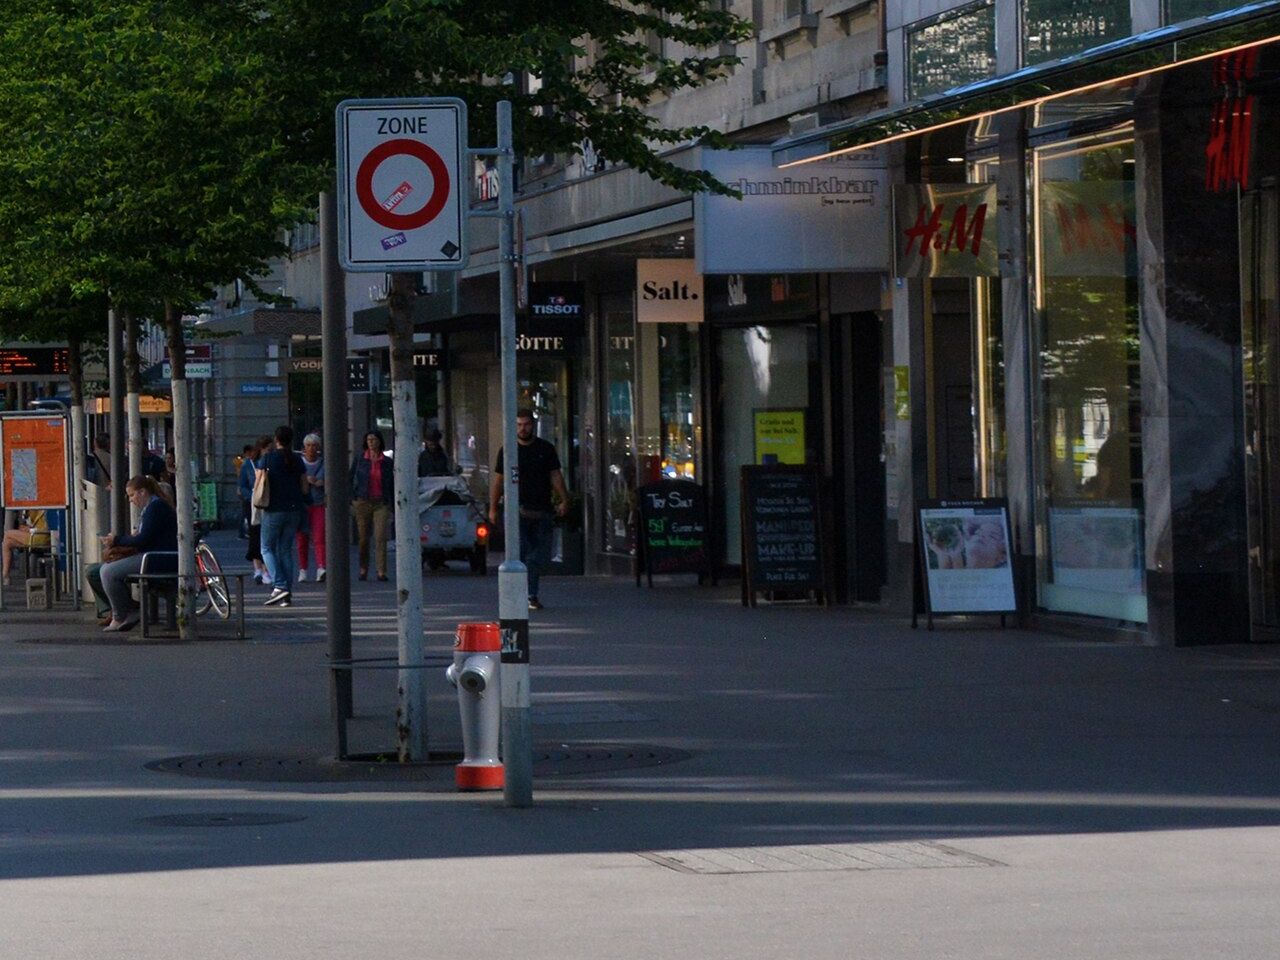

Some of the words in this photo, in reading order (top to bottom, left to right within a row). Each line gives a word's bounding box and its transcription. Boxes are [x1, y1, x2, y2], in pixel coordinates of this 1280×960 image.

[377, 117, 428, 135] ZONE
[712, 177, 879, 195] chminkbar
[904, 203, 988, 257] H&M
[643, 280, 700, 300] Salt.
[532, 304, 581, 314] TISSOT
